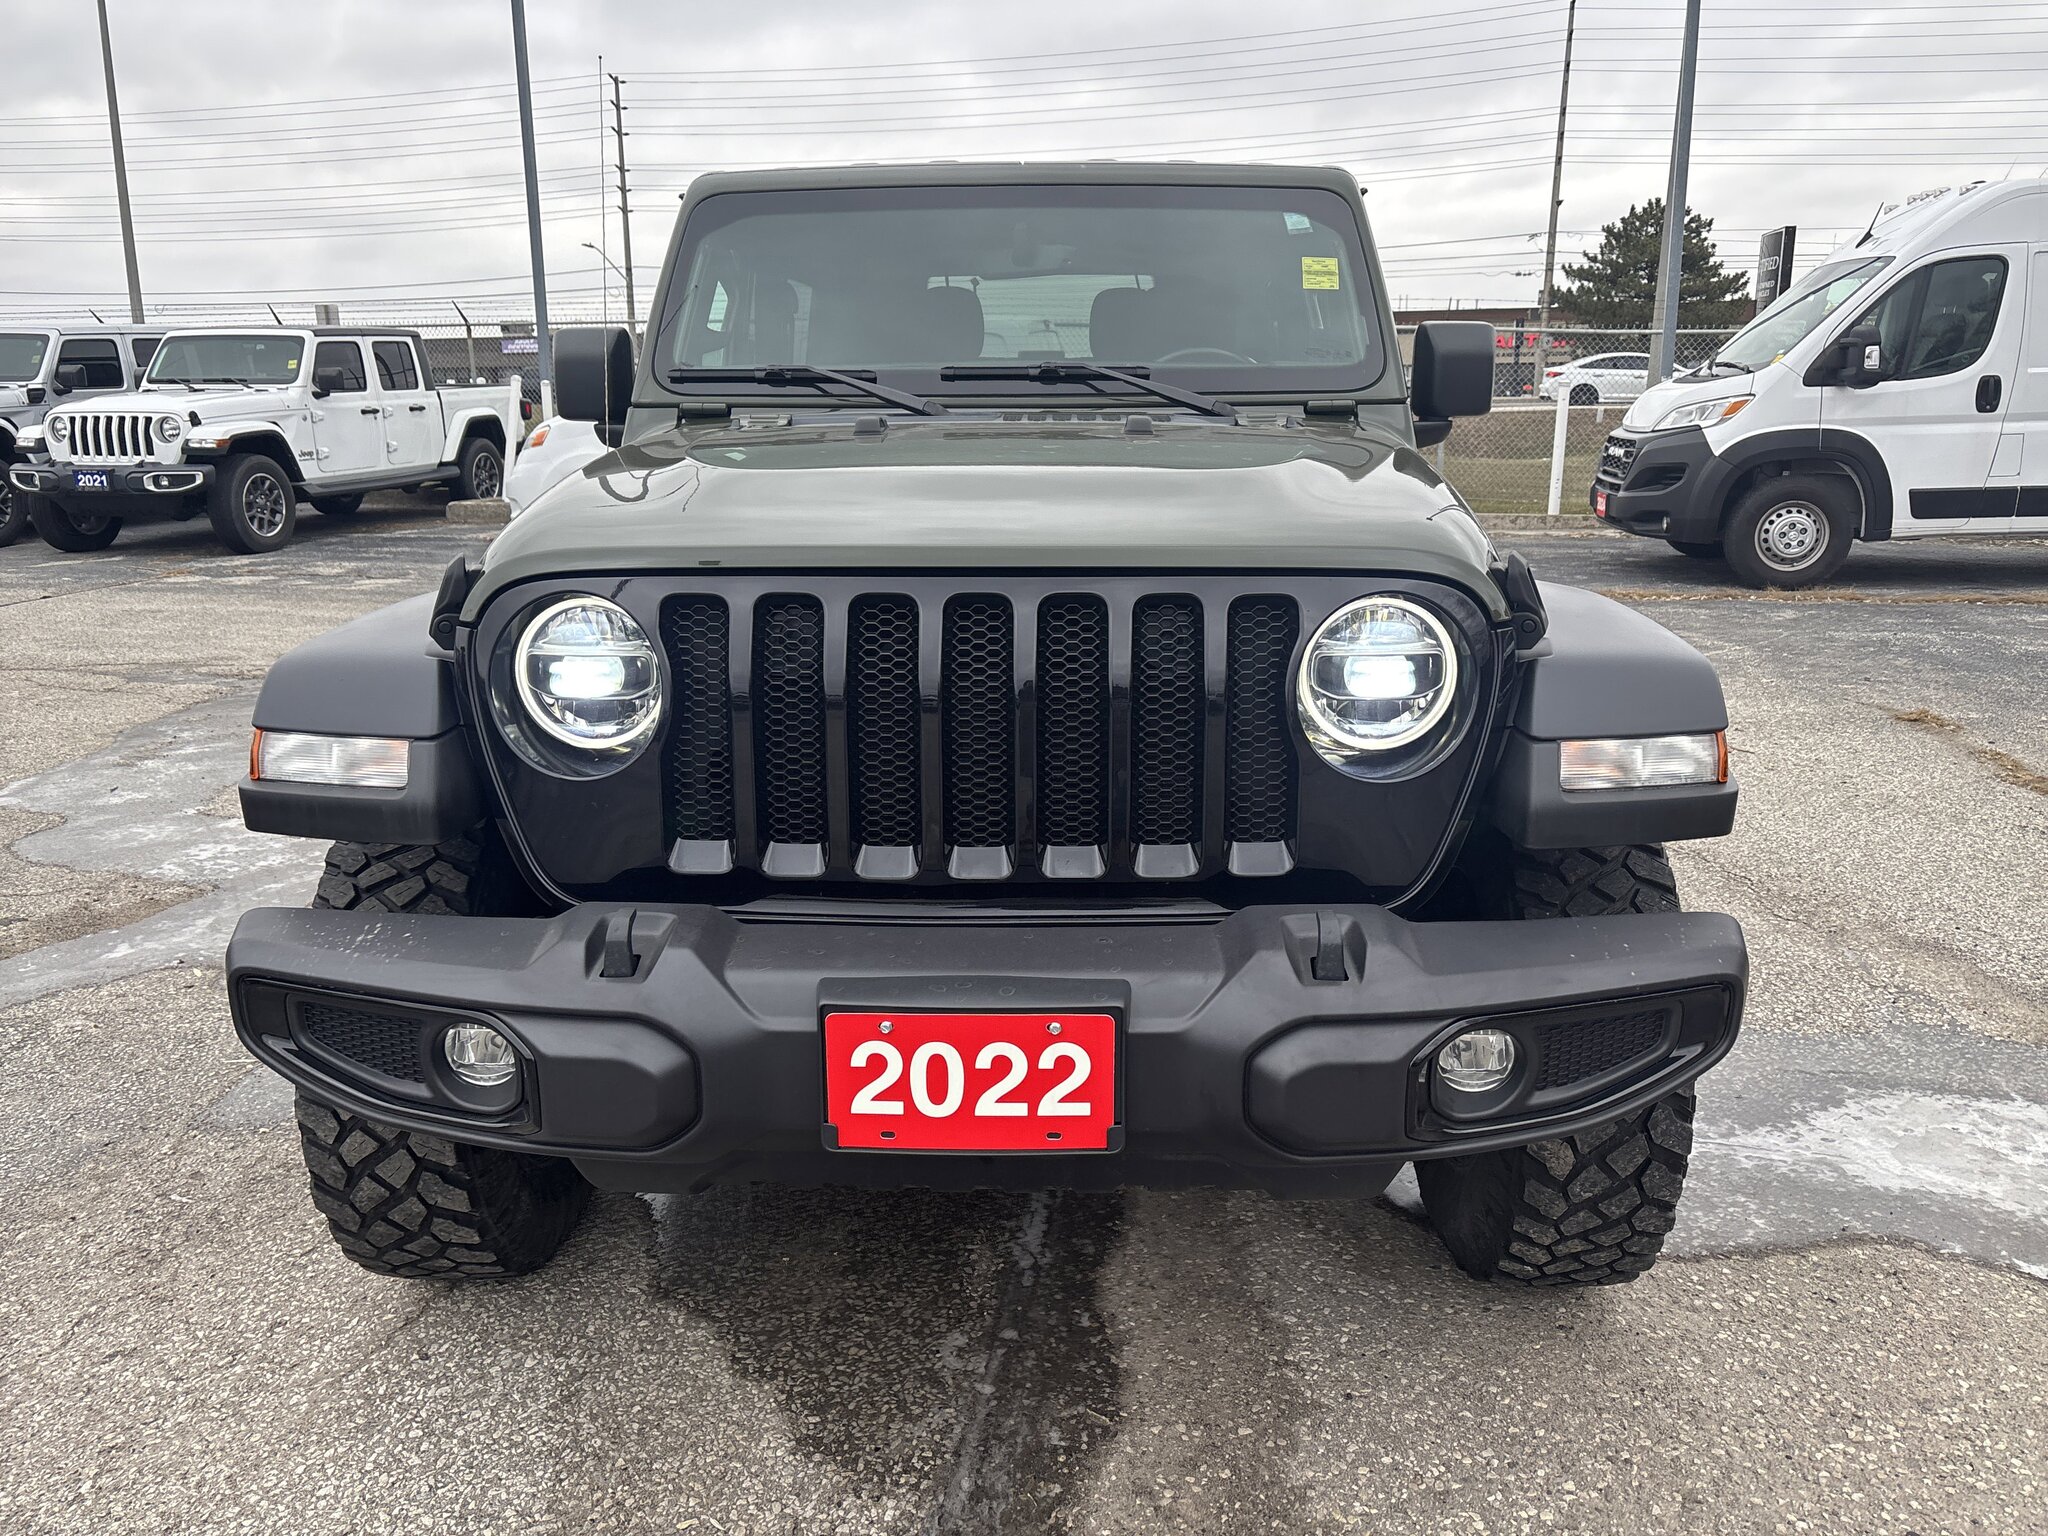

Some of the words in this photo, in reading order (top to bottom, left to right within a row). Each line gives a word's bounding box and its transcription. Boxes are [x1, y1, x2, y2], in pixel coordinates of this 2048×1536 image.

[298, 449, 314, 458] Jeep
[1608, 446, 1625, 457] RAM
[77, 474, 108, 487] 2021
[850, 1040, 1092, 1118] 2022
